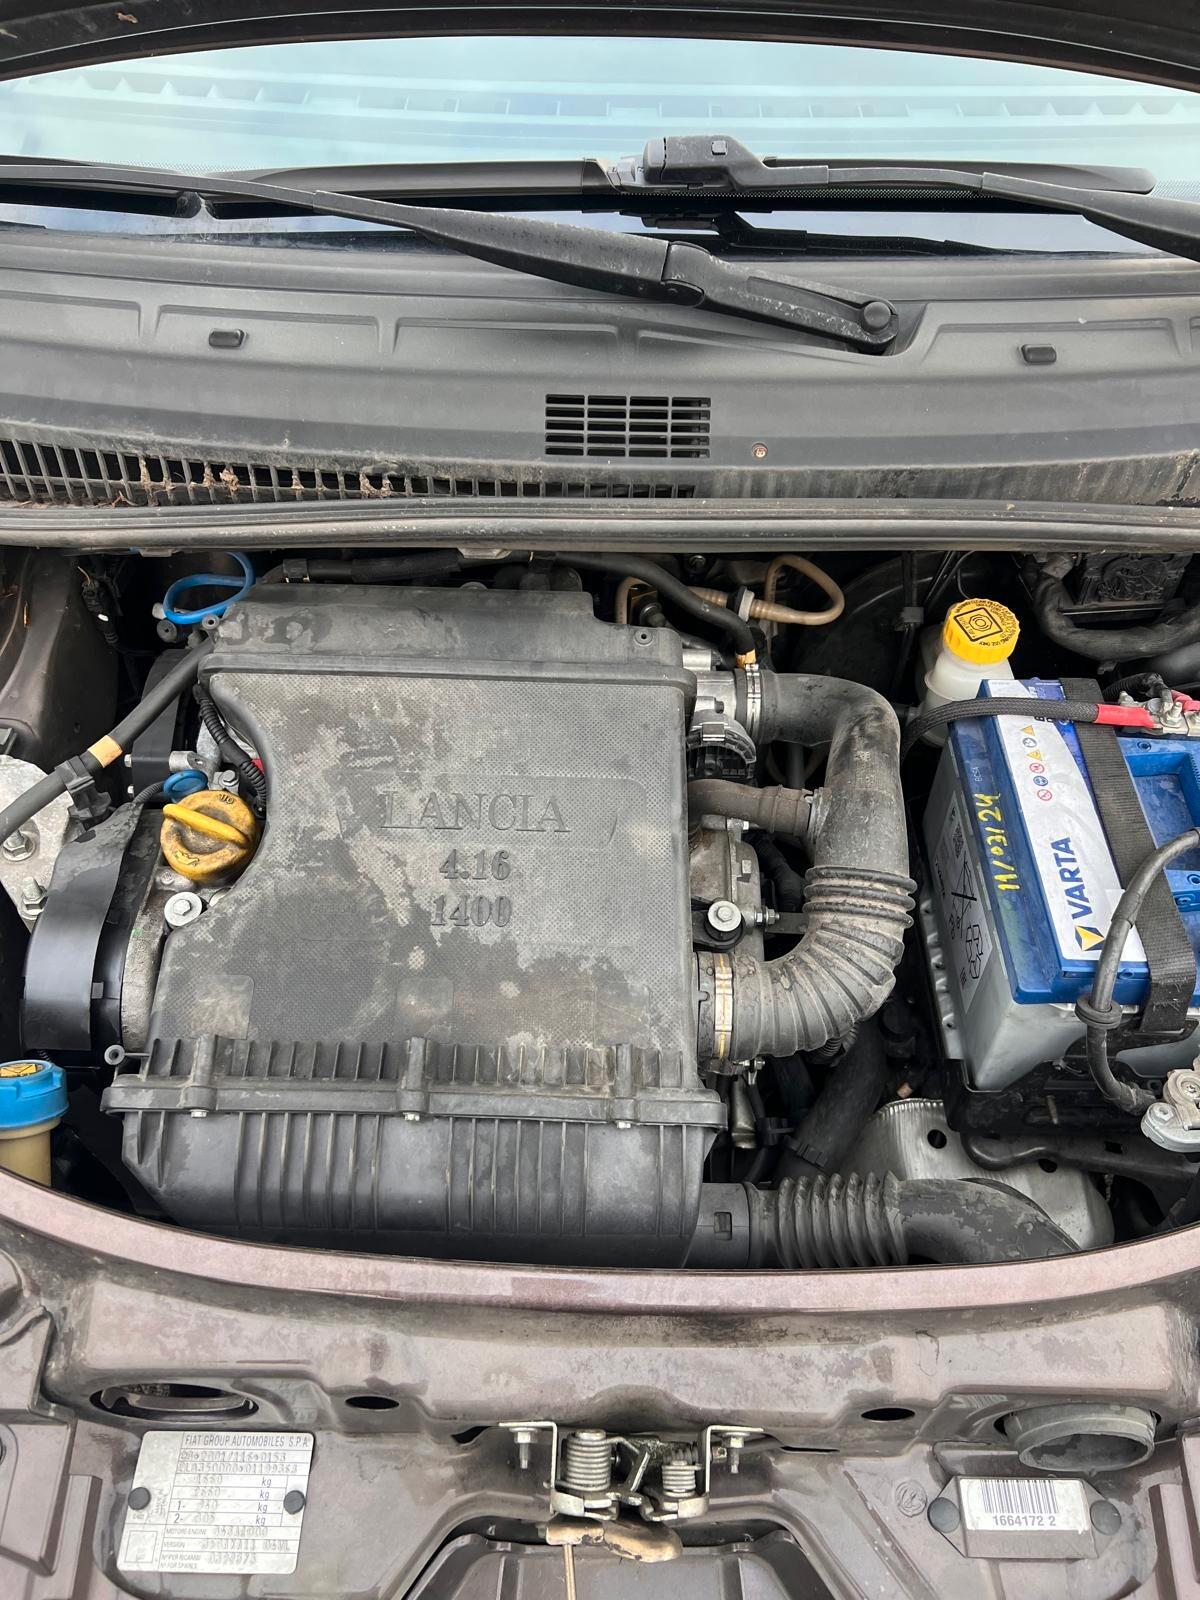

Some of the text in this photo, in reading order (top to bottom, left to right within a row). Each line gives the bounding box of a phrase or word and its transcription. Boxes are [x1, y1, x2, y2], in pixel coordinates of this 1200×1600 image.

[379, 790, 572, 832] LANCIA
[439, 848, 511, 880] 4.16
[1050, 837, 1093, 920] VARTA
[431, 894, 512, 927] 1400
[185, 1434, 201, 1445] FIAT
[203, 1434, 229, 1446] GROUP
[231, 1435, 284, 1447] AUTOMOBILES
[262, 1476, 272, 1488] kg
[260, 1490, 270, 1501] kg
[257, 1502, 268, 1513] kg
[255, 1515, 266, 1526] kg
[993, 1515, 1056, 1526] 1664172 2
